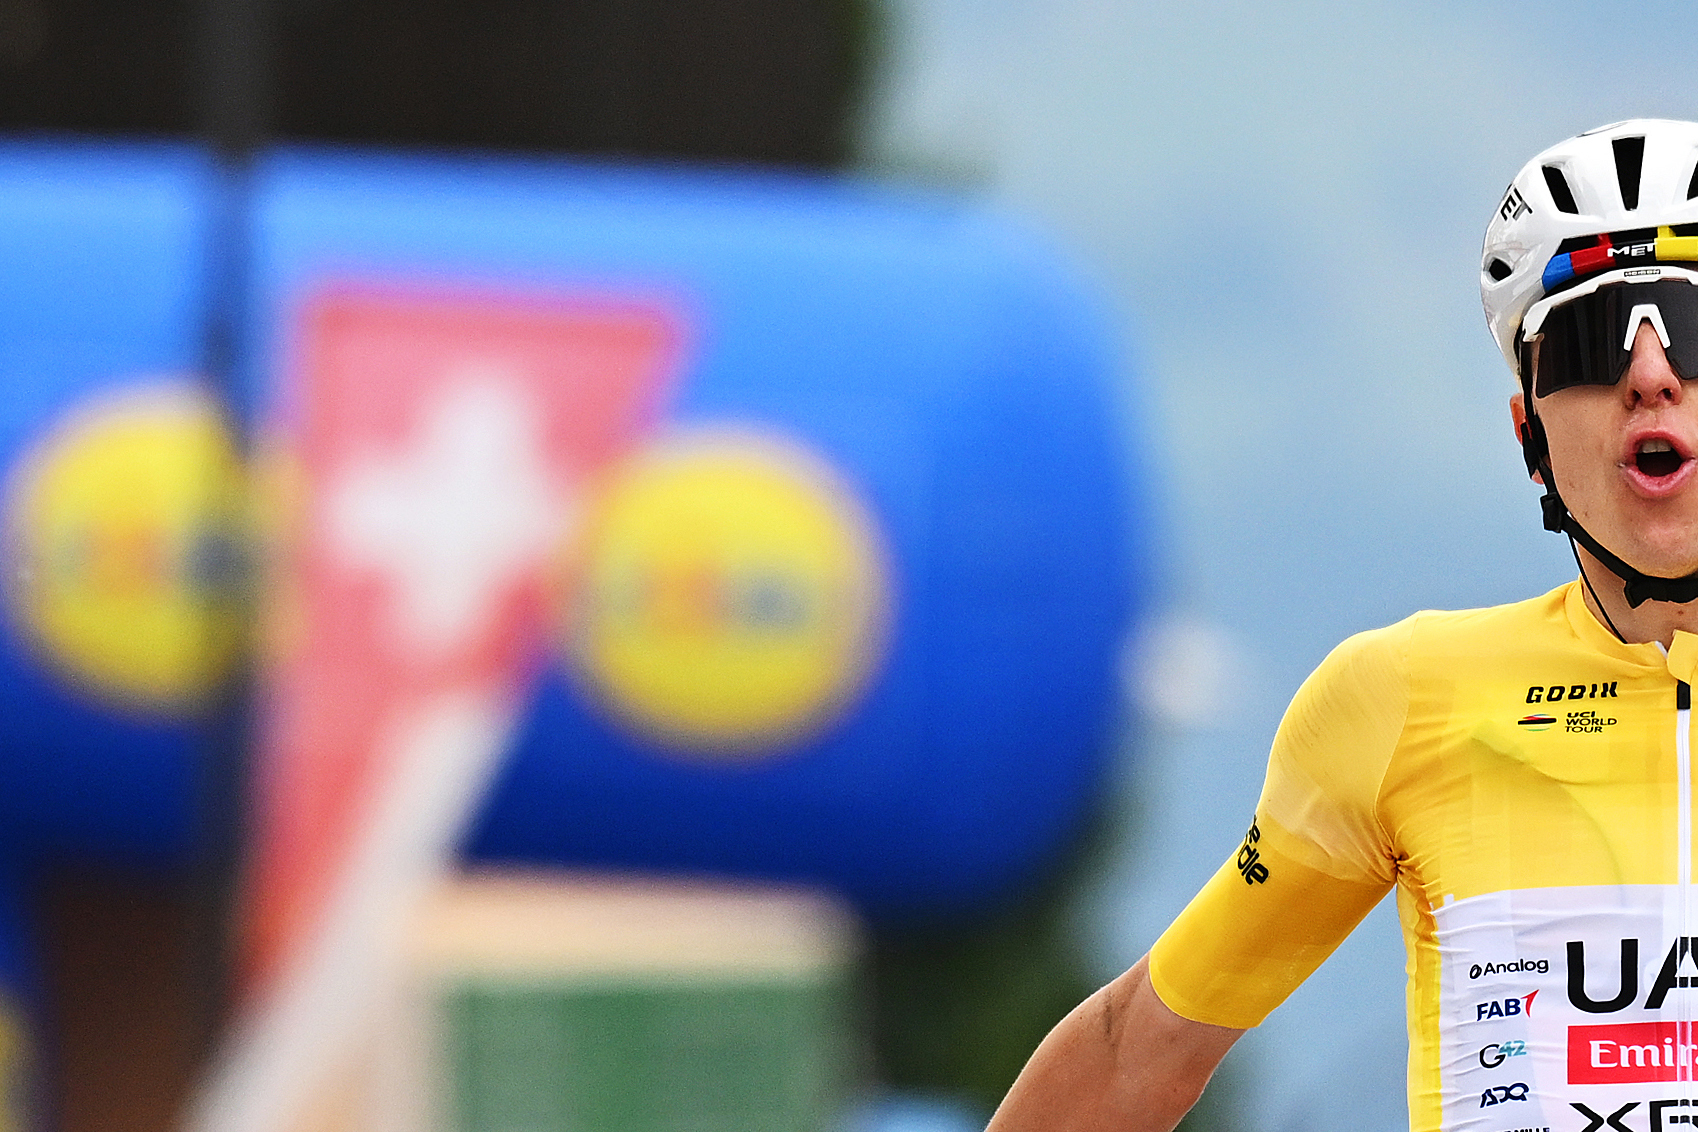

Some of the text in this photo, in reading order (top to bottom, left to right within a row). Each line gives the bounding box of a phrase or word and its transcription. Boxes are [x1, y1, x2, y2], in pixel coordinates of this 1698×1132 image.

[1501, 184, 1533, 221] ET
[1607, 242, 1658, 258] MET
[1566, 718, 1618, 726] WORLD
[1483, 958, 1550, 977] Analog
[1476, 998, 1522, 1022] FAB
[1479, 1039, 1528, 1069] G42
[1479, 1082, 1530, 1109] ADQ
